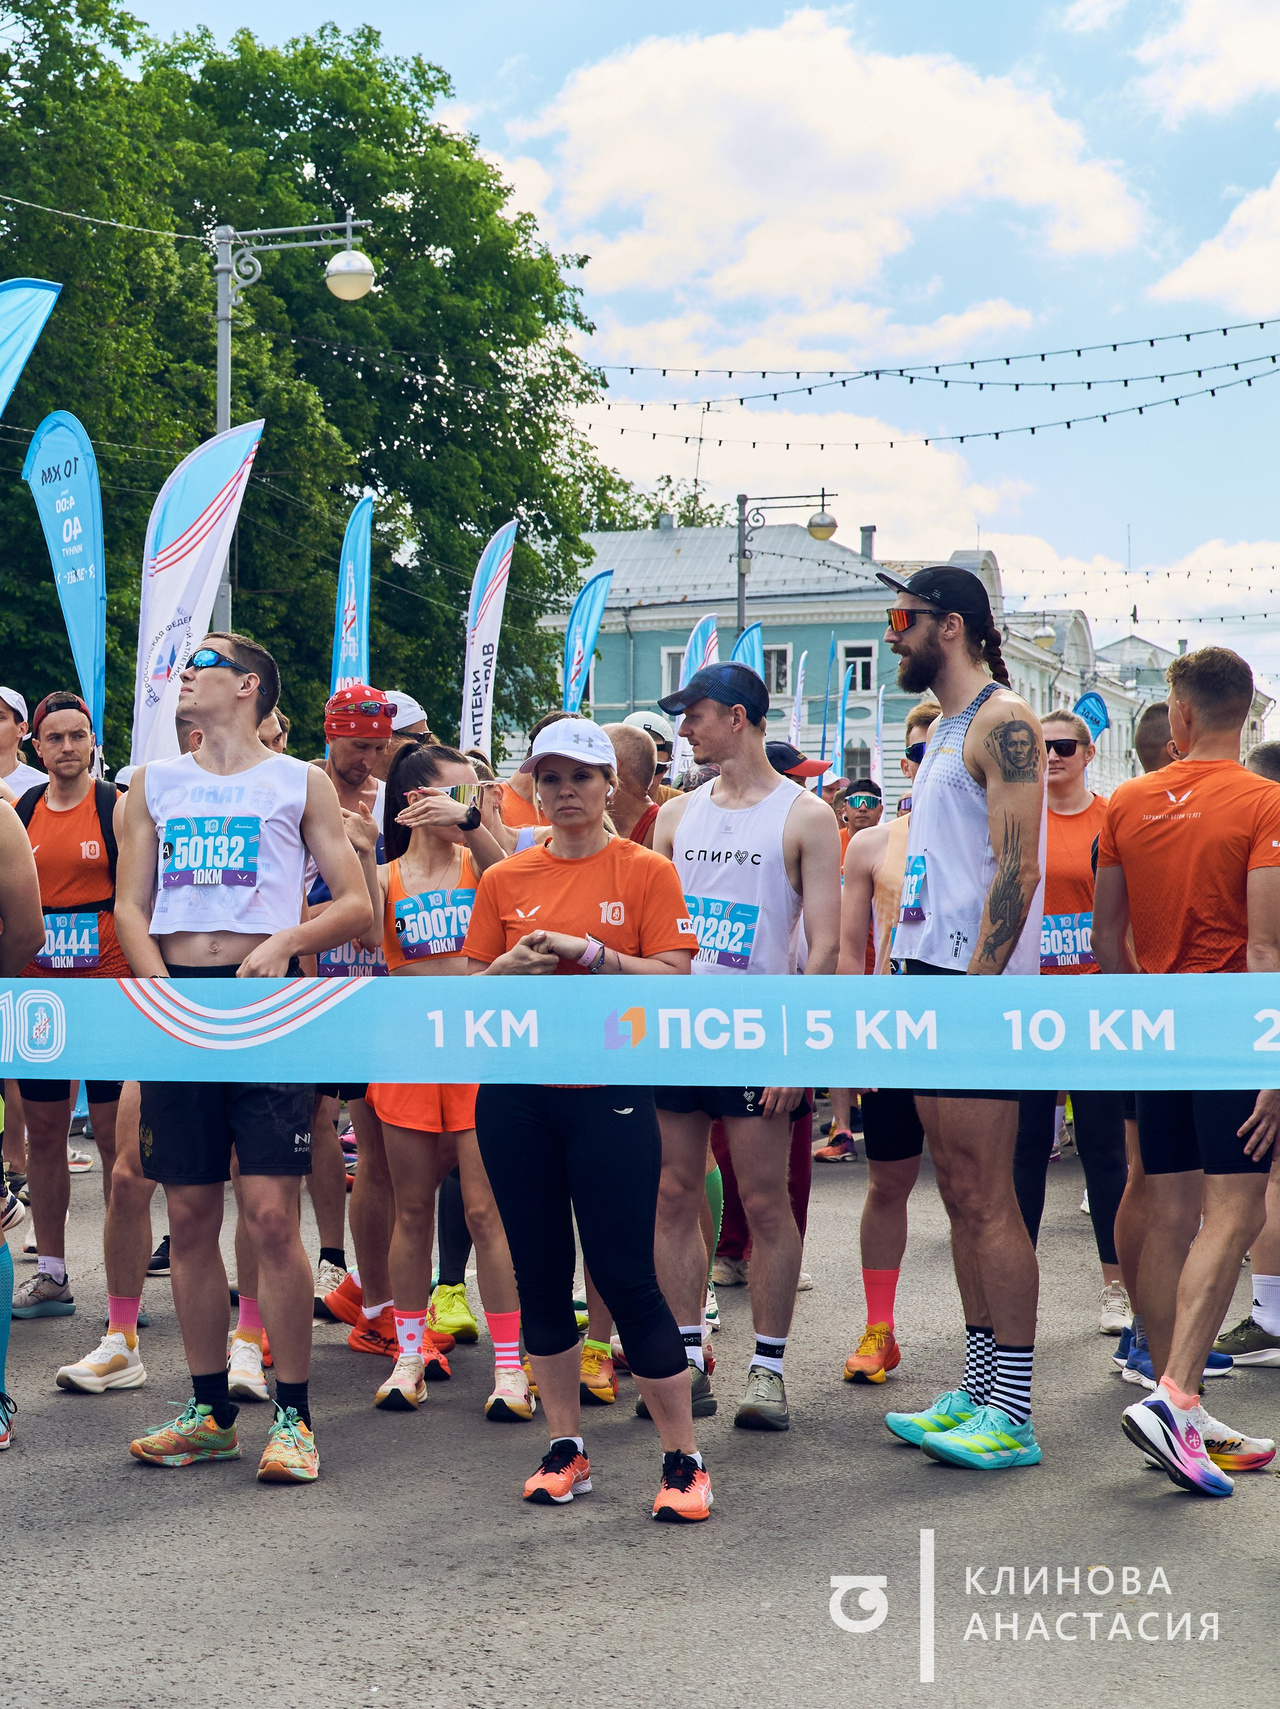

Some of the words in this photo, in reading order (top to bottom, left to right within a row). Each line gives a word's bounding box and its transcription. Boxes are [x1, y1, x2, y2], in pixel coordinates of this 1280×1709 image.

[79, 840, 100, 860] 10
[174, 835, 246, 870] 50132
[404, 904, 473, 944] 50079
[598, 900, 625, 926] 10
[38, 928, 92, 956] 0444
[690, 913, 747, 953] 0282
[1040, 926, 1093, 956] 50310
[427, 1010, 444, 1048] 1
[465, 1010, 539, 1048] КМ
[658, 1007, 766, 1050] ПСБ
[804, 1009, 835, 1050] 5
[855, 1009, 938, 1050] КМ
[1002, 1009, 1066, 1051] 10
[1089, 1009, 1176, 1051] КМ
